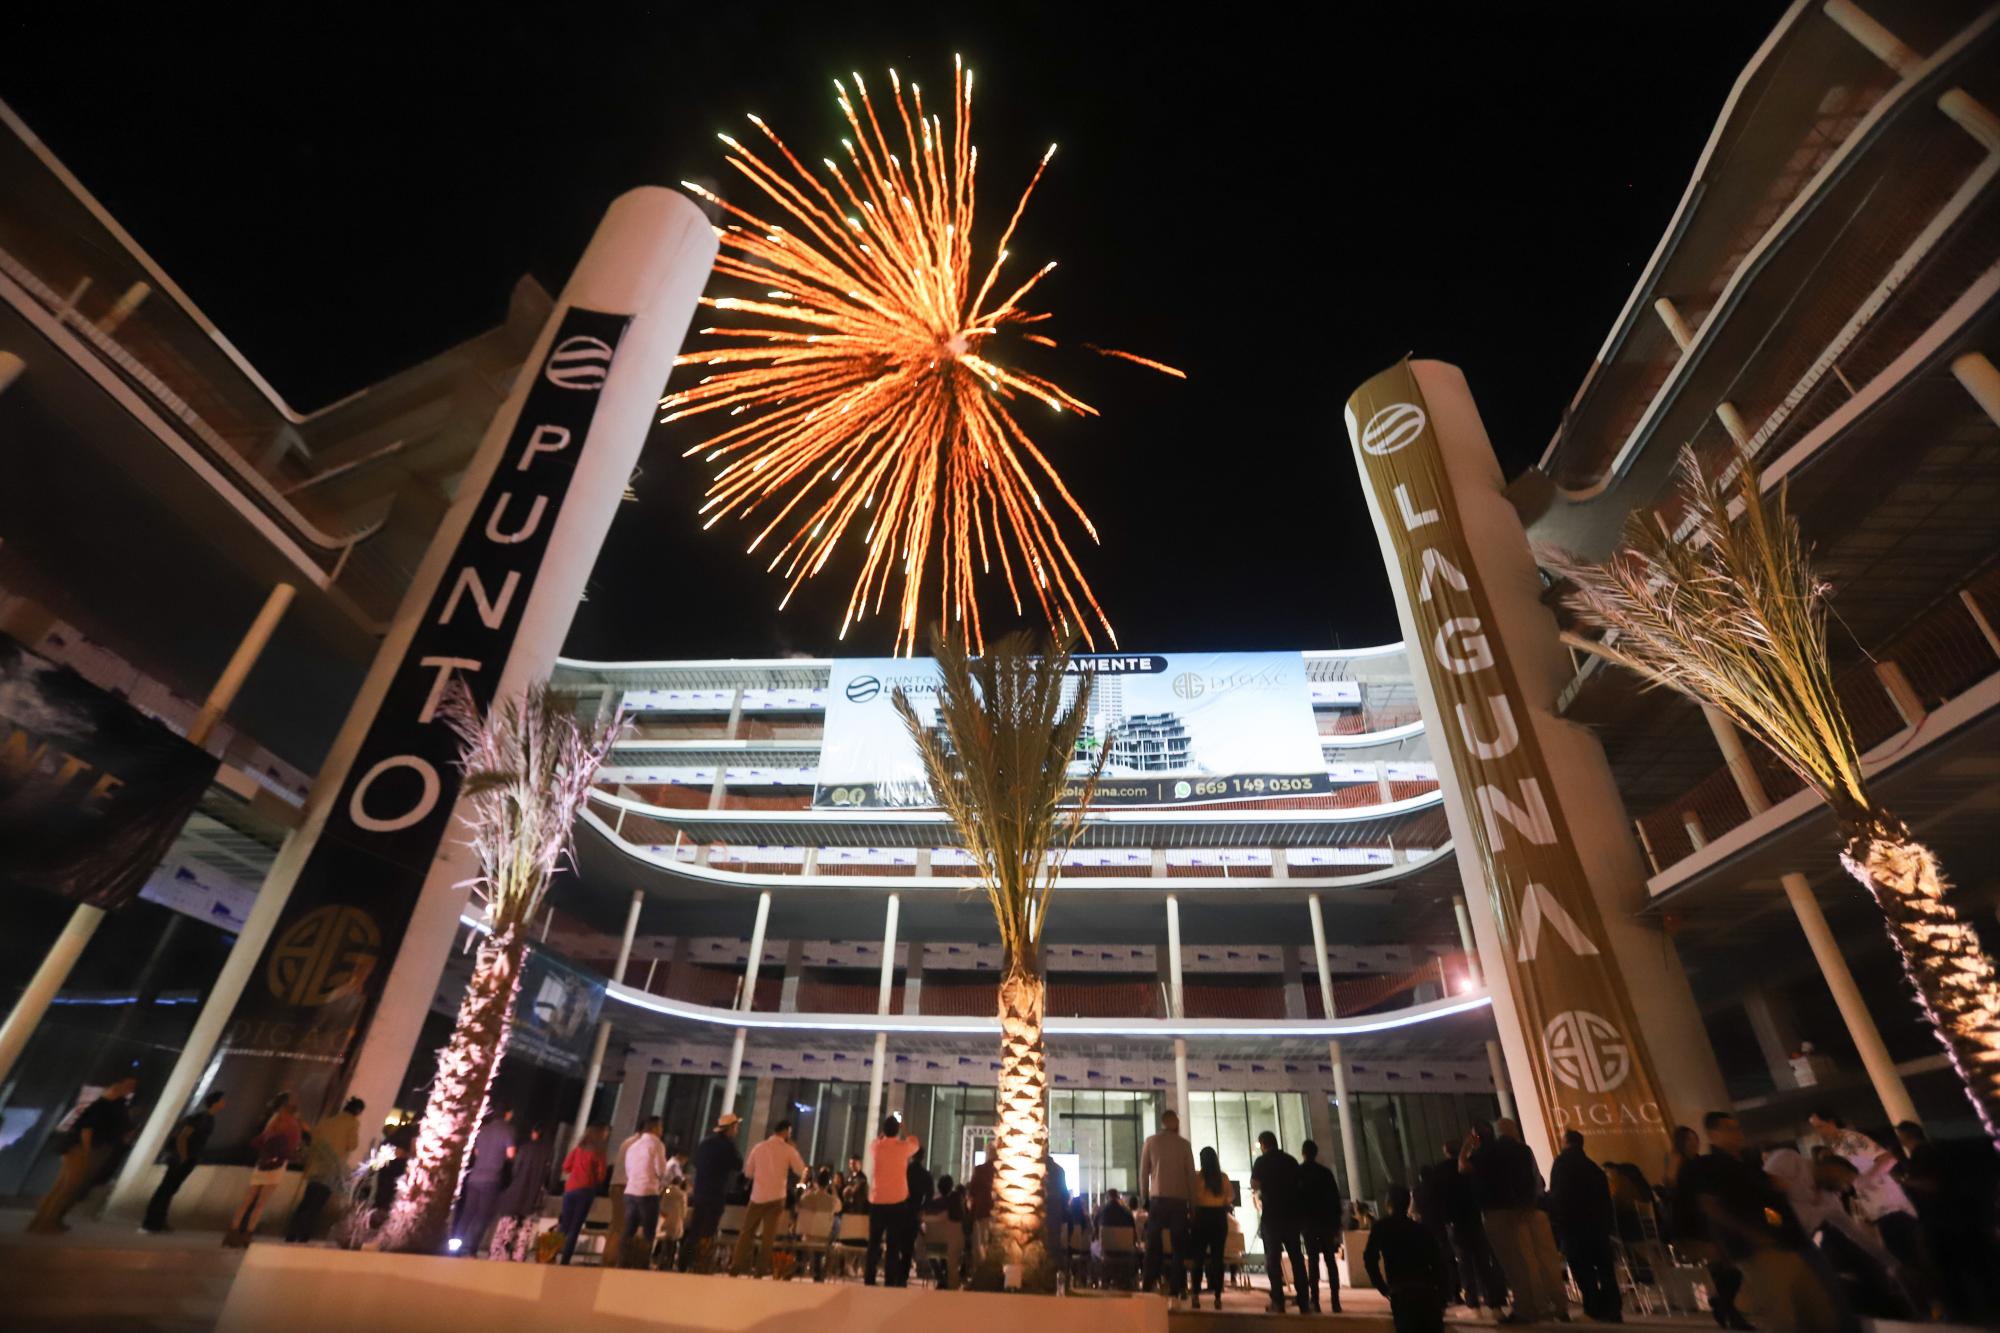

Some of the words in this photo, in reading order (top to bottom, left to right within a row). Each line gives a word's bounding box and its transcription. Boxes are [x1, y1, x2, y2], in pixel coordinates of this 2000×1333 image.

[349, 425, 571, 833] PUNTO
[883, 684, 946, 694] LGUN
[1393, 482, 1599, 962] LAGUNA
[1195, 781, 1227, 796] 669
[1233, 778, 1265, 792] 149
[1269, 777, 1313, 792] 0303
[1551, 1101, 1664, 1128] DIGAC
